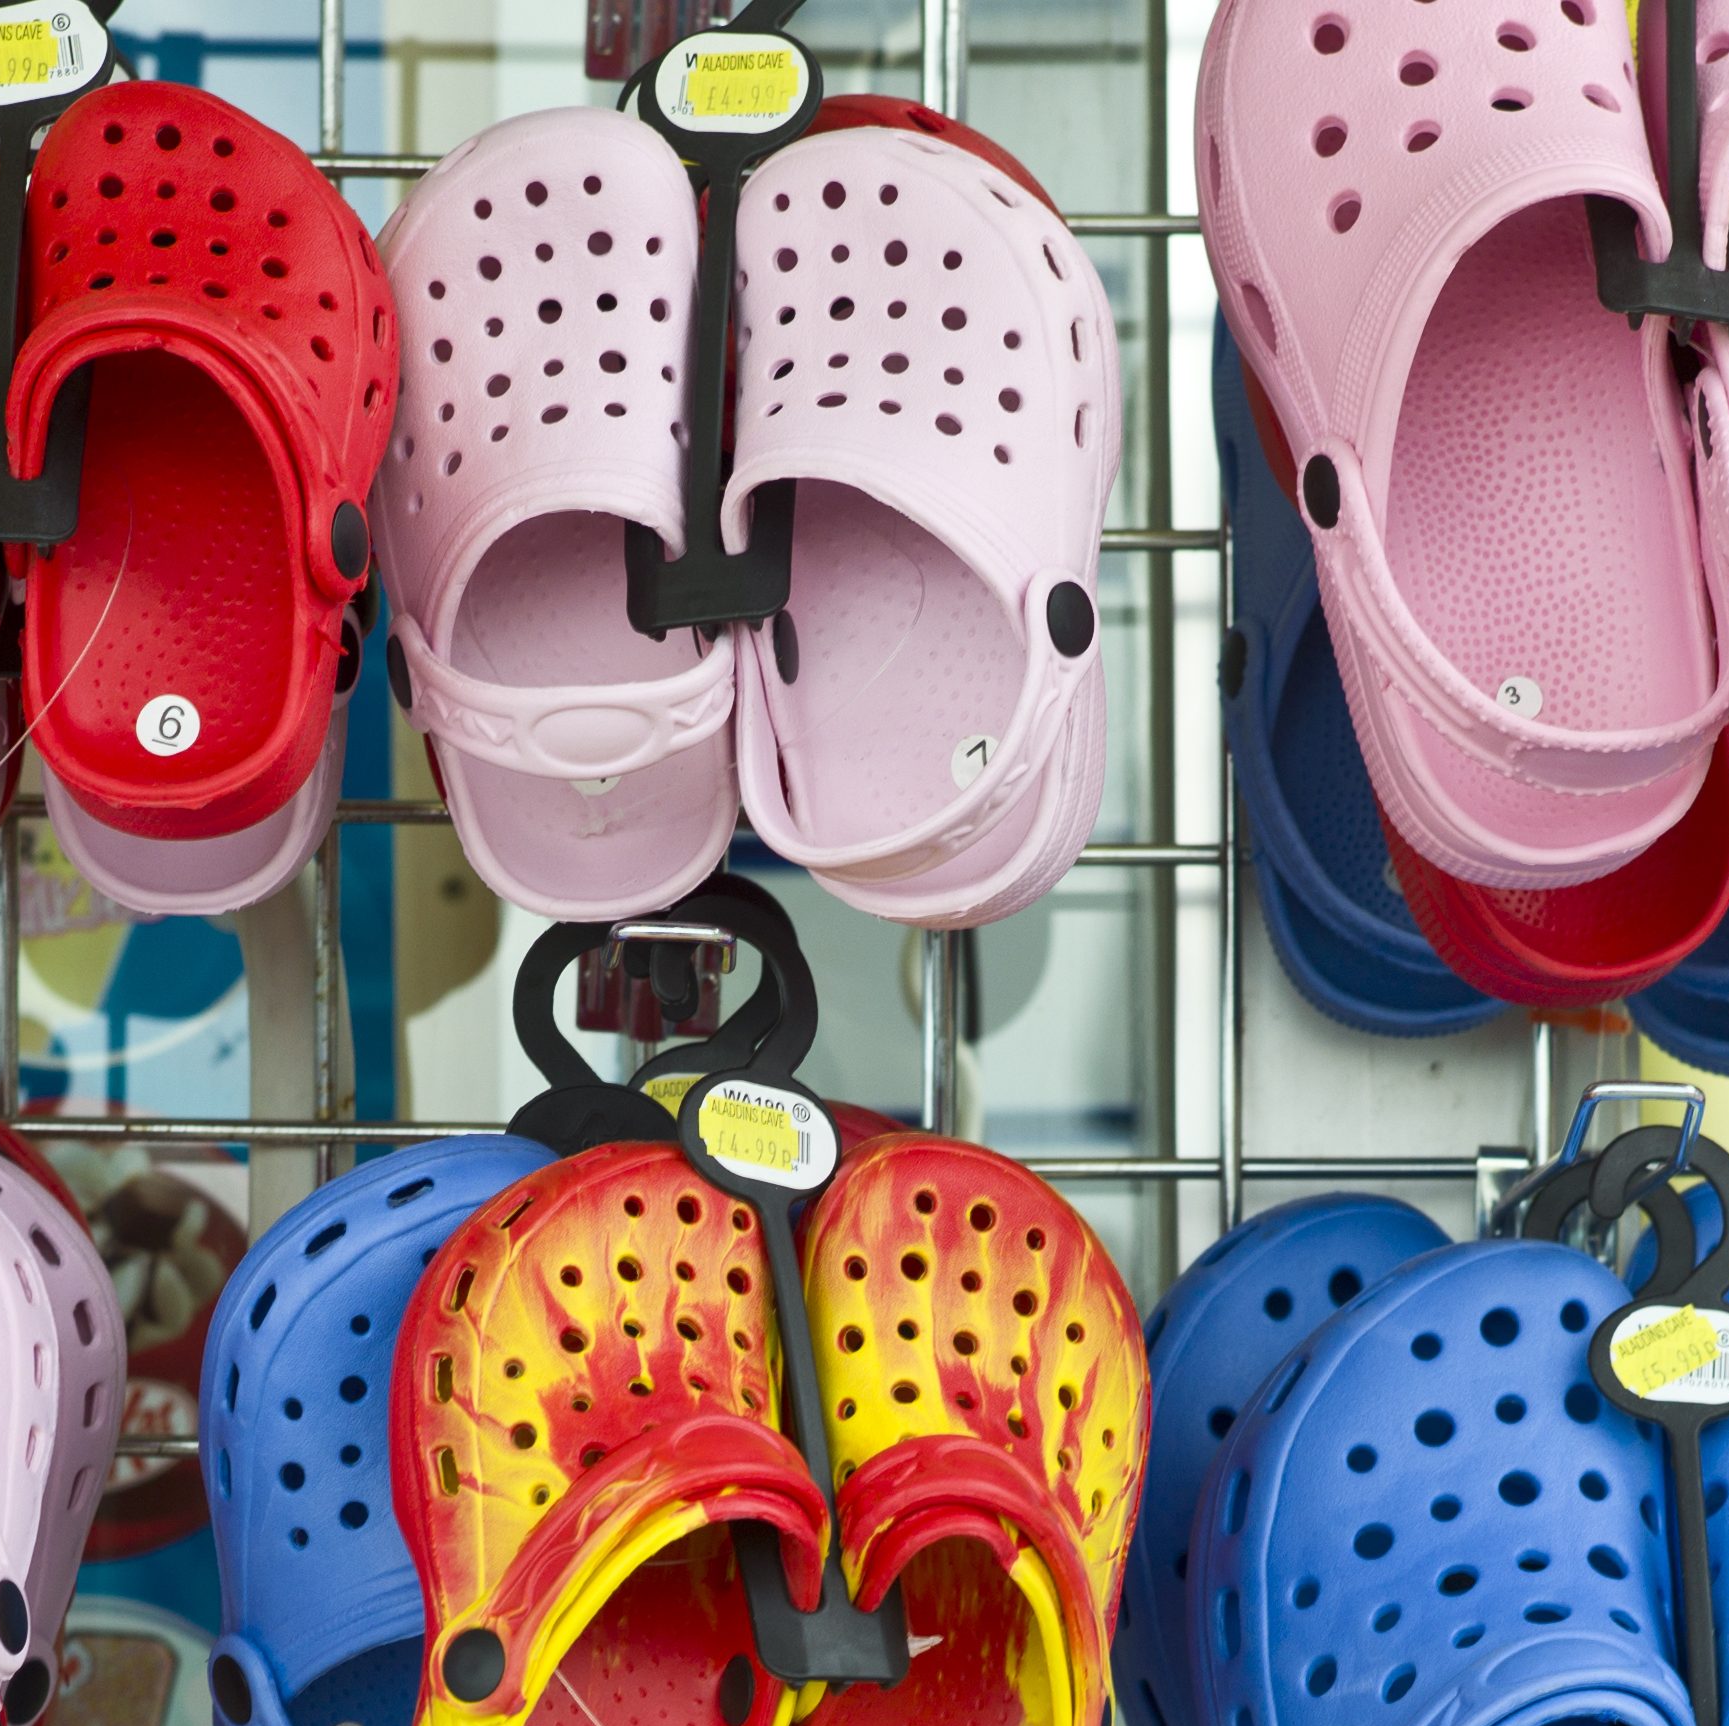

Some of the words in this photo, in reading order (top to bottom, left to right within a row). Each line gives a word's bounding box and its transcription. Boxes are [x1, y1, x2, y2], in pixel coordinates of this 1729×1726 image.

[15, 24, 43, 40] CAVE
[702, 55, 755, 71] ALADDINS
[757, 53, 784, 69] CAVE
[1504, 686, 1520, 705] 3
[157, 706, 184, 742] 6
[966, 739, 988, 767] 7
[711, 1099, 759, 1123] ALADDINS
[761, 1111, 785, 1129] CAVE
[794, 1105, 808, 1121] 10
[718, 1130, 792, 1168] £4.99p
[1618, 1323, 1667, 1359] ALADDINS
[1665, 1310, 1693, 1334] CAVE
